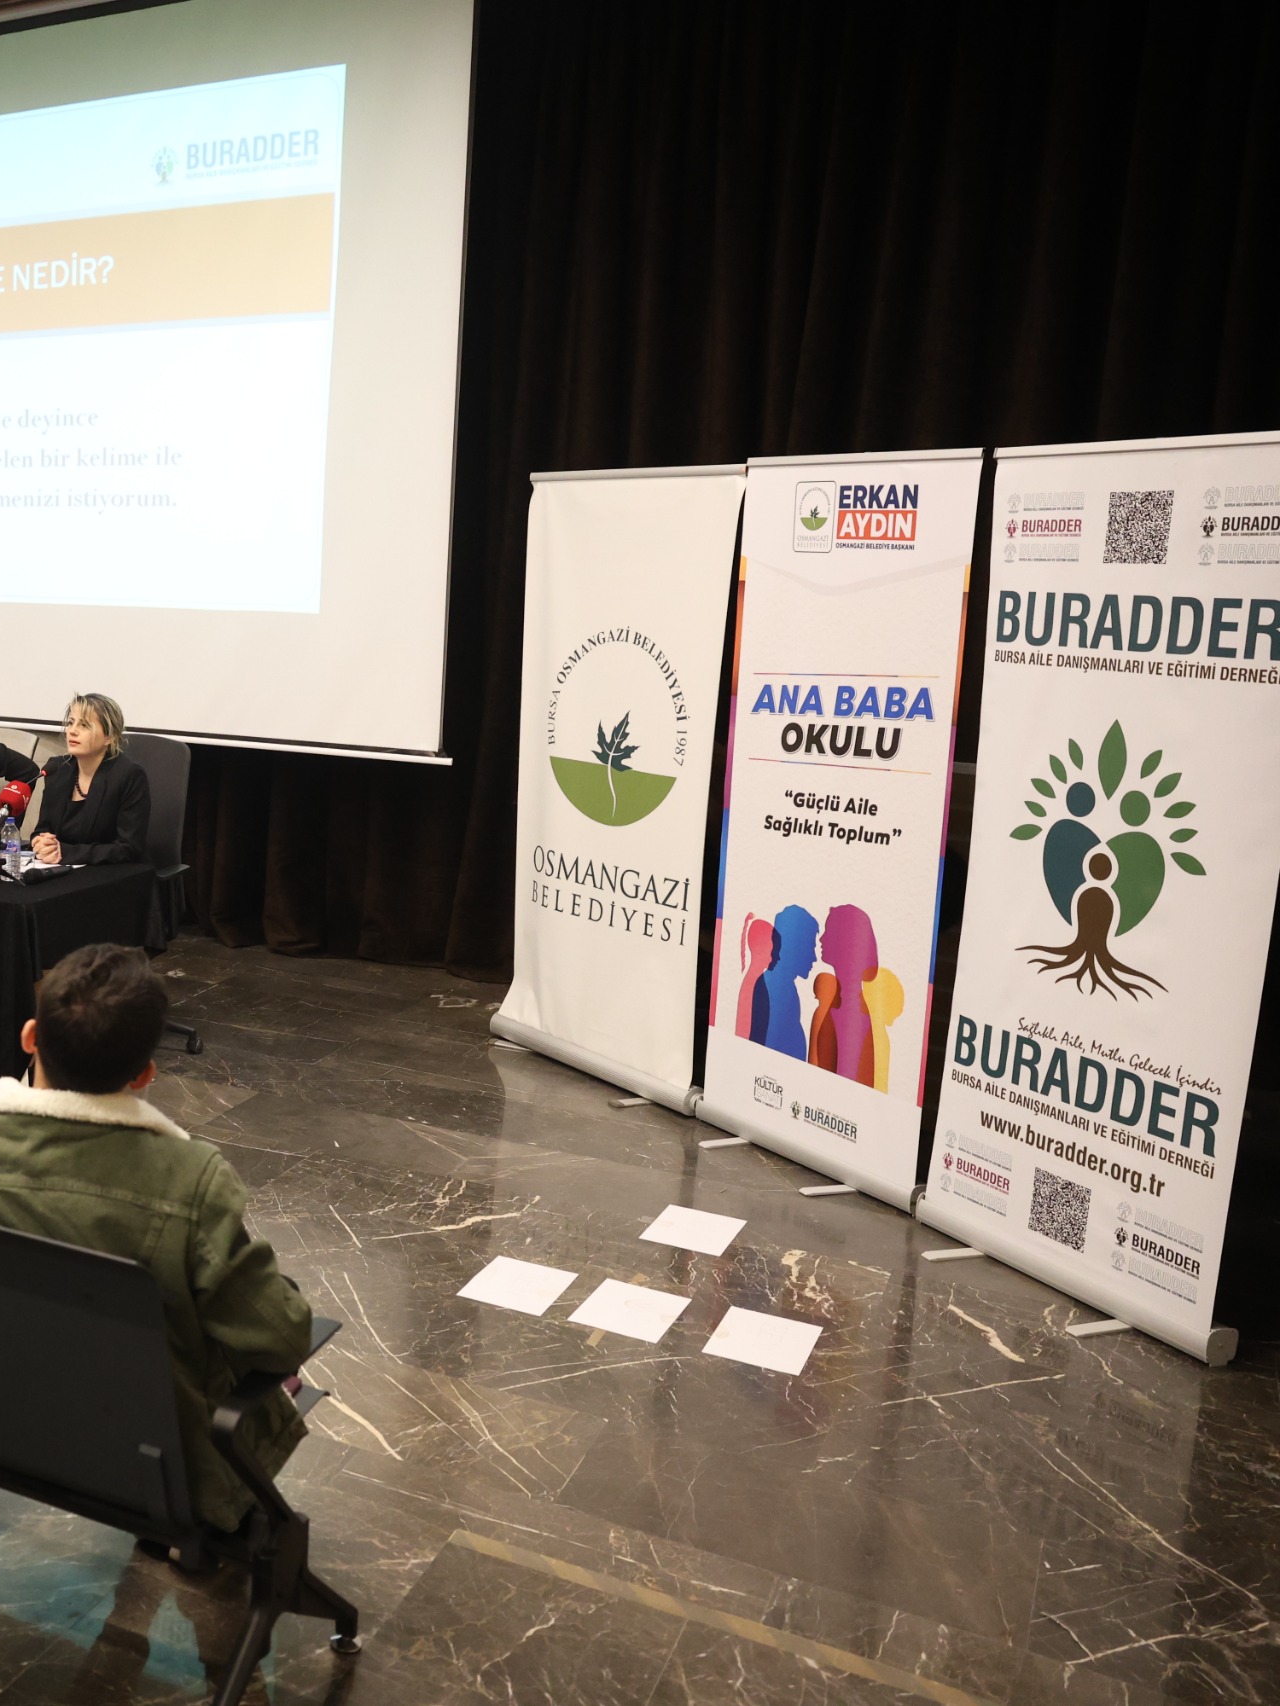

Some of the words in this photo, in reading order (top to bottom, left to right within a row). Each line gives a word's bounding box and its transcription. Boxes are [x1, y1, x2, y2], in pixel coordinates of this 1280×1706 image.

[186, 129, 320, 170] BURADDER
[13, 252, 114, 290] NEDİR?
[17, 408, 99, 436] deyince
[40, 448, 71, 468] bir
[77, 447, 149, 467] kelime
[155, 446, 183, 466] ile
[67, 488, 178, 515] istiyorum.
[838, 484, 919, 509] ERKAN
[839, 512, 913, 538] AYDIN
[1021, 519, 1082, 533] BURADDER
[866, 542, 890, 550] BELEDİYE
[890, 543, 915, 551] BAŞKANI
[1218, 543, 1280, 560] BURADD
[996, 590, 1280, 661] BURADDER
[994, 650, 1026, 665] BURSA
[1028, 652, 1053, 667] AİLE
[1056, 657, 1144, 675] DANIŞMANLARI
[1148, 661, 1163, 676] VE
[1166, 660, 1217, 680] EĞİTİMİ
[1220, 664, 1280, 685] DERNEĞ
[547, 689, 561, 745] BURSA
[556, 626, 630, 684] OSMANGAZİ
[632, 631, 690, 722] BELEDİYESİ
[673, 730, 688, 767] 1987
[750, 684, 825, 716] ANA
[833, 686, 935, 721] BABA
[780, 722, 903, 761] OKULU
[784, 790, 840, 814] “Güçlü
[843, 797, 878, 816] Aile
[764, 814, 823, 837] Sağlıklı
[828, 822, 902, 845] Toplum”
[533, 845, 690, 913] OSMANGAZİ
[531, 879, 686, 947] BELEDİYESİ
[1018, 1017, 1057, 1039] Sağlıklı
[1060, 1031, 1086, 1053] Aile,
[1090, 1040, 1125, 1063] Mutlu
[1129, 1053, 1172, 1079] Gelecek
[1176, 1065, 1222, 1096] İçindir
[754, 1076, 783, 1096] KÜLTÜR
[953, 1014, 1220, 1158] BURADDER
[804, 1106, 857, 1139] BURADDER
[951, 1069, 982, 1091] BURSA
[984, 1081, 1007, 1100] AİLE
[1008, 1091, 1090, 1132] DANIŞMANLARI
[1093, 1121, 1108, 1138] VE
[1110, 1129, 1156, 1156] EĞİTİMİ
[1159, 1147, 1215, 1179] DERNEĞİ
[980, 1111, 1165, 1197] www.buradder.org.tr
[956, 1157, 1010, 1191] BURADDER
[1132, 1233, 1200, 1275] BURADDER
